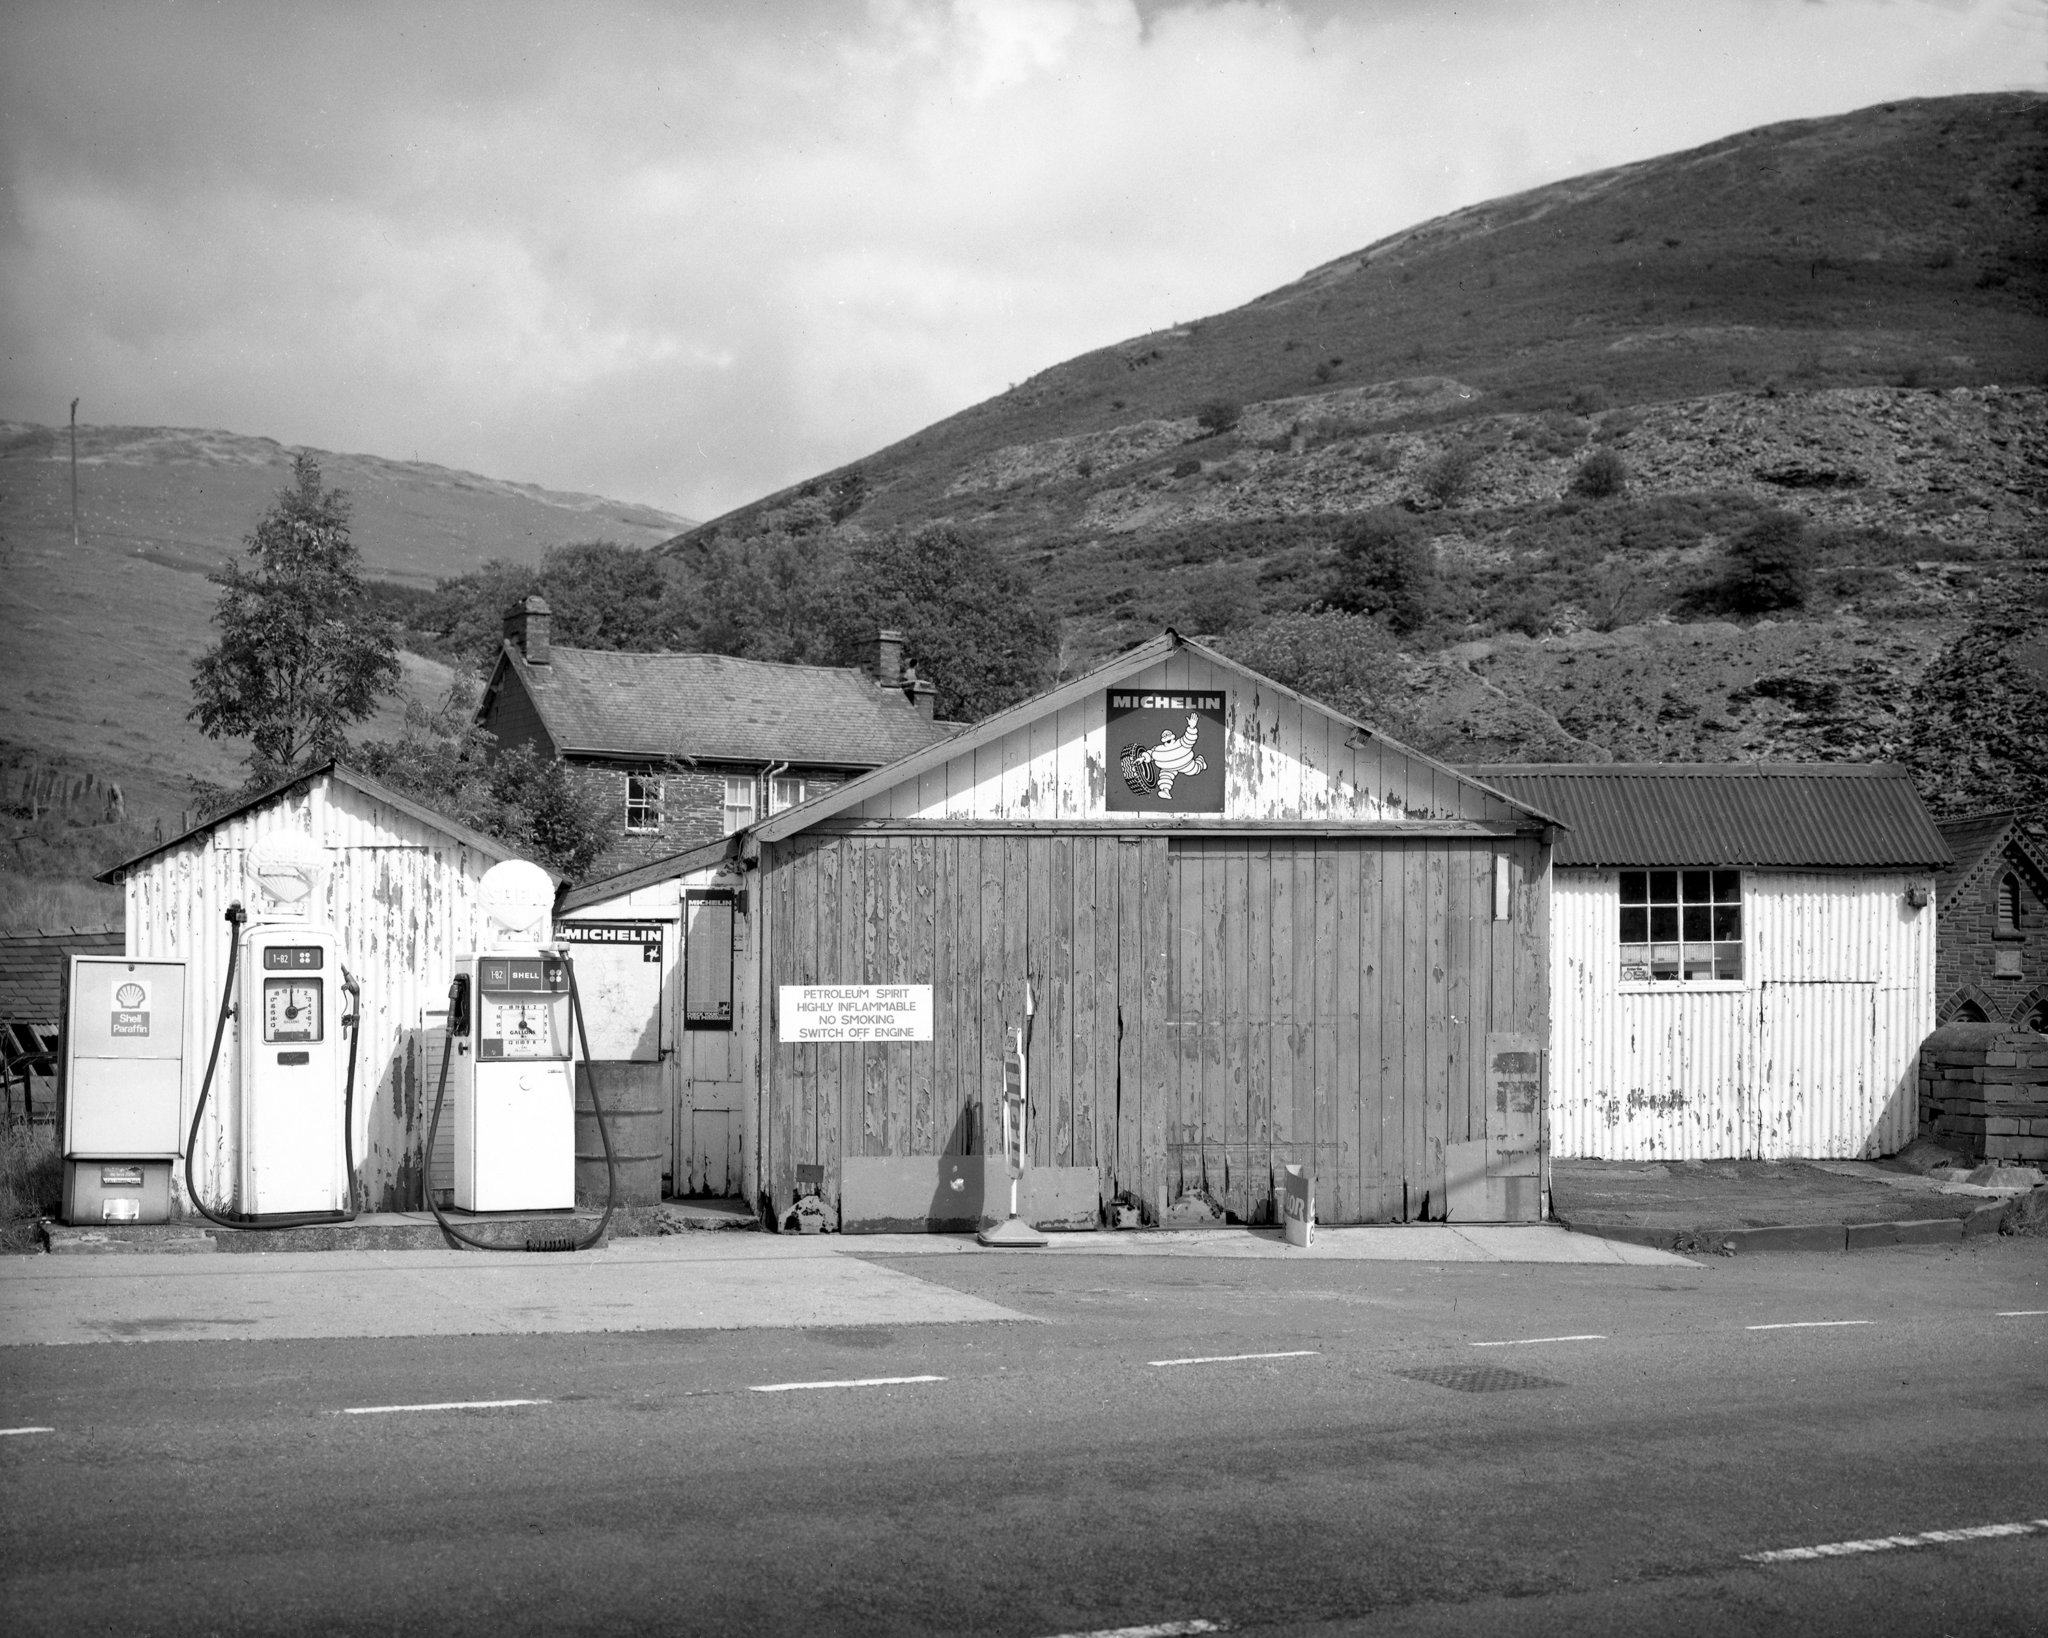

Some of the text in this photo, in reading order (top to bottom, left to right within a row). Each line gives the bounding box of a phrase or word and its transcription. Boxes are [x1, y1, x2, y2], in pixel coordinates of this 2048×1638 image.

[1113, 695, 1220, 710] MICHELIN
[564, 928, 662, 942] MICHELIN
[273, 954, 288, 963] 1-82
[803, 988, 910, 999] PETROLEUM SPIRIT
[797, 1002, 917, 1012] HIGHLY INFLAMMABLE
[119, 1013, 141, 1023] Shell
[819, 1015, 895, 1025] NO SMOKING
[113, 1024, 148, 1033] Paraffin
[799, 1027, 914, 1038] SWITCH OFF ENGINE
